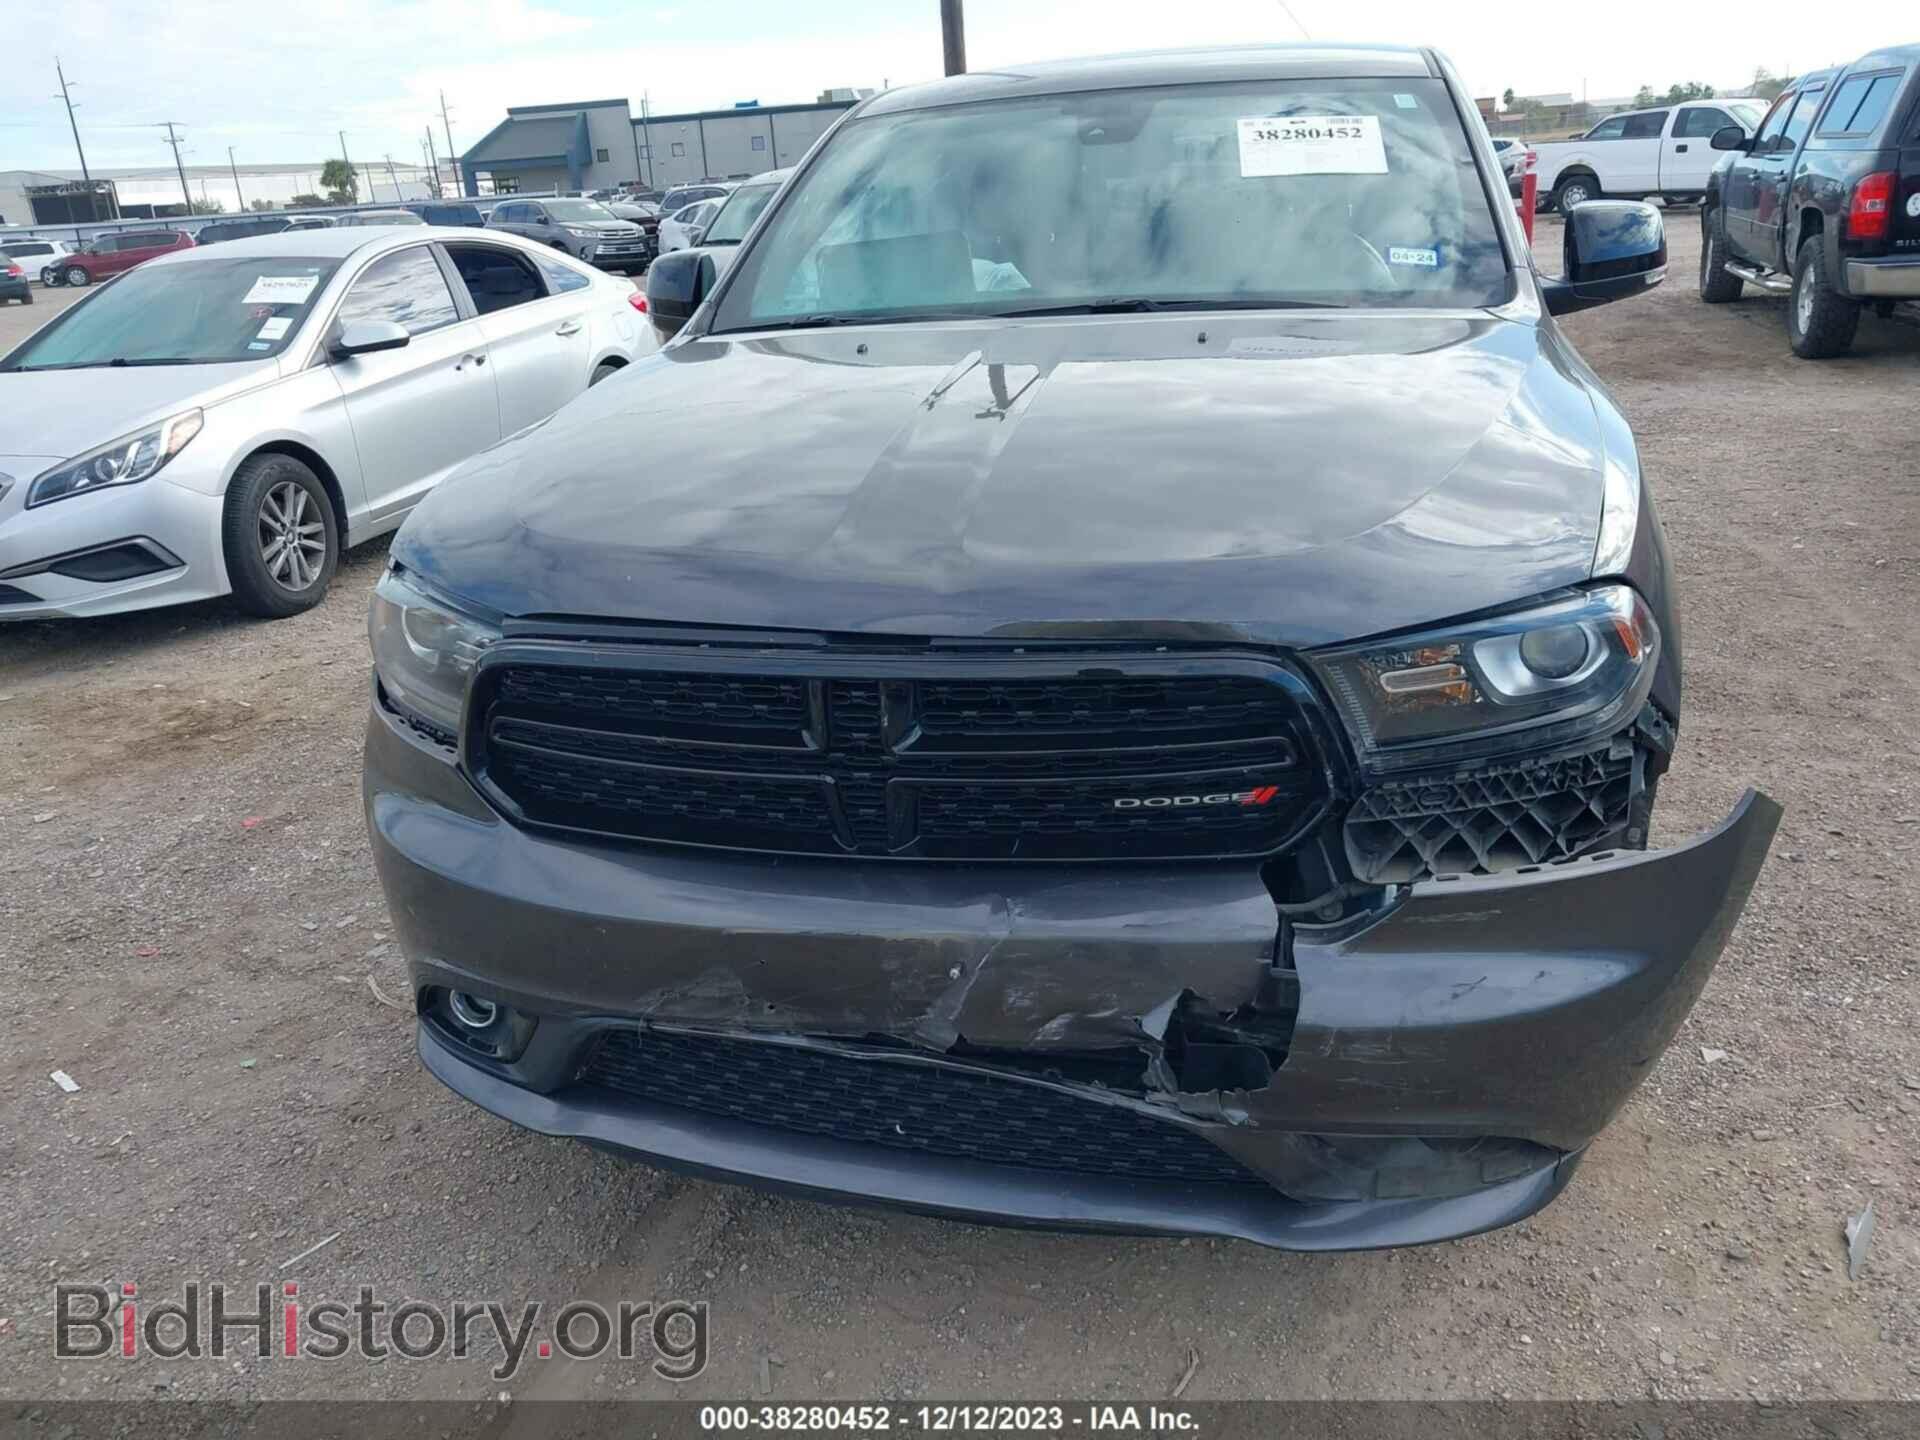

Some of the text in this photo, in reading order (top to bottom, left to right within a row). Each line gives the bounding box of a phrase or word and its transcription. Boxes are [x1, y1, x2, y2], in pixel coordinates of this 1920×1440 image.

[1252, 127, 1363, 142] 38280452
[1391, 252, 1434, 262] 04-24
[1114, 791, 1256, 808] DODGE
